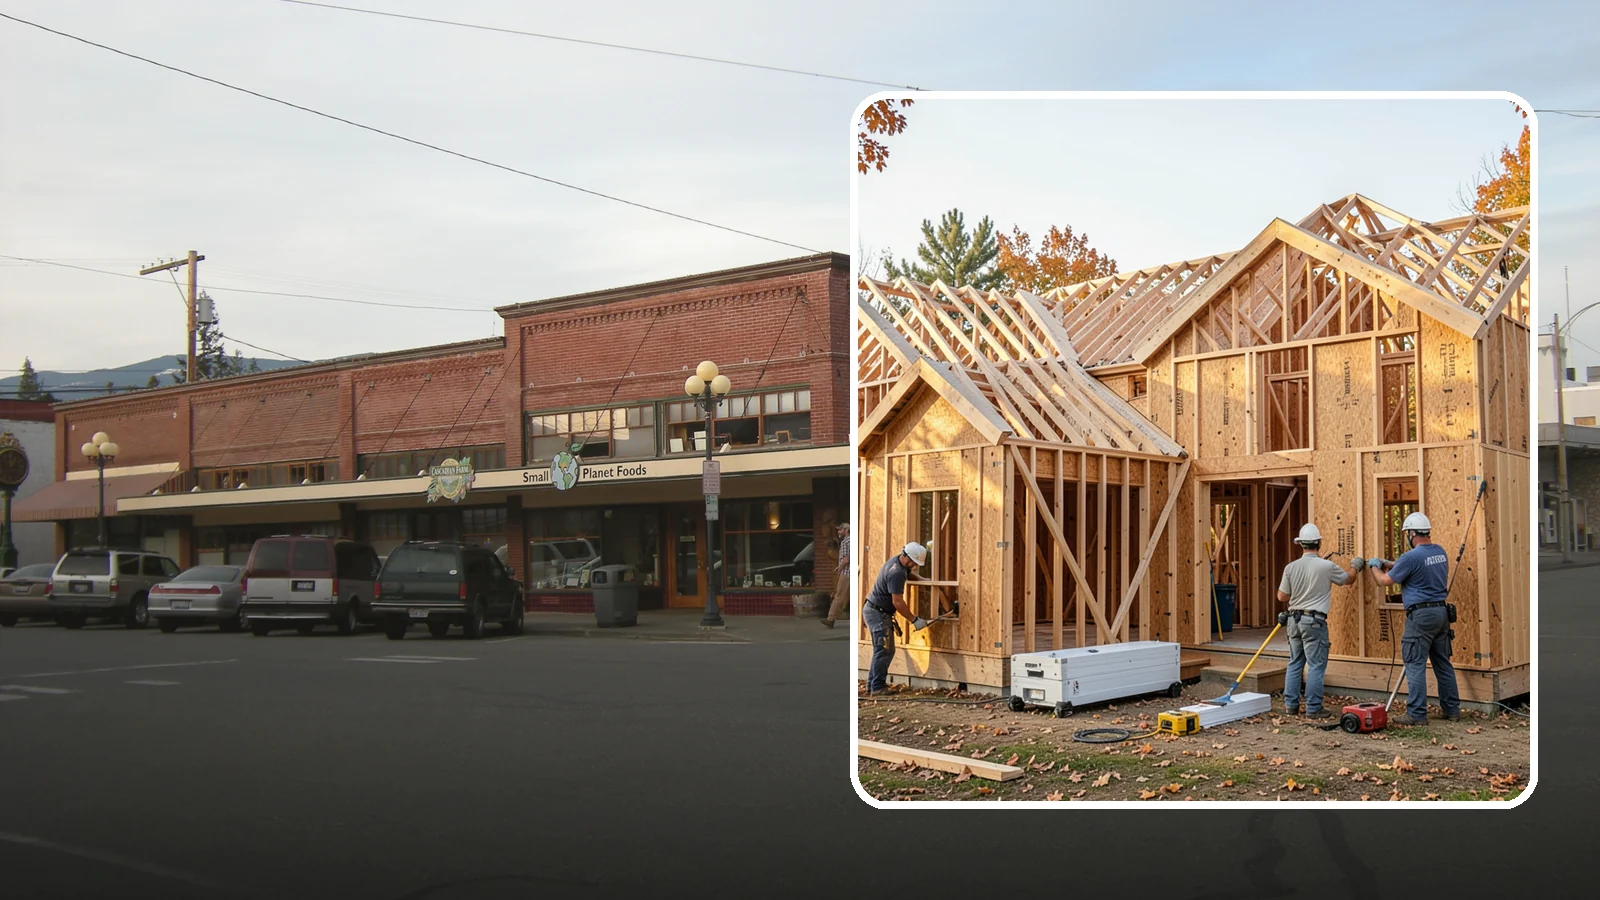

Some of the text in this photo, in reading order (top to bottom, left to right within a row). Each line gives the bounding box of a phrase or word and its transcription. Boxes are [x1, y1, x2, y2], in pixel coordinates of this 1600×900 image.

[431, 466, 455, 476] CASCADIAN
[523, 464, 647, 483] Small Planet Foods
